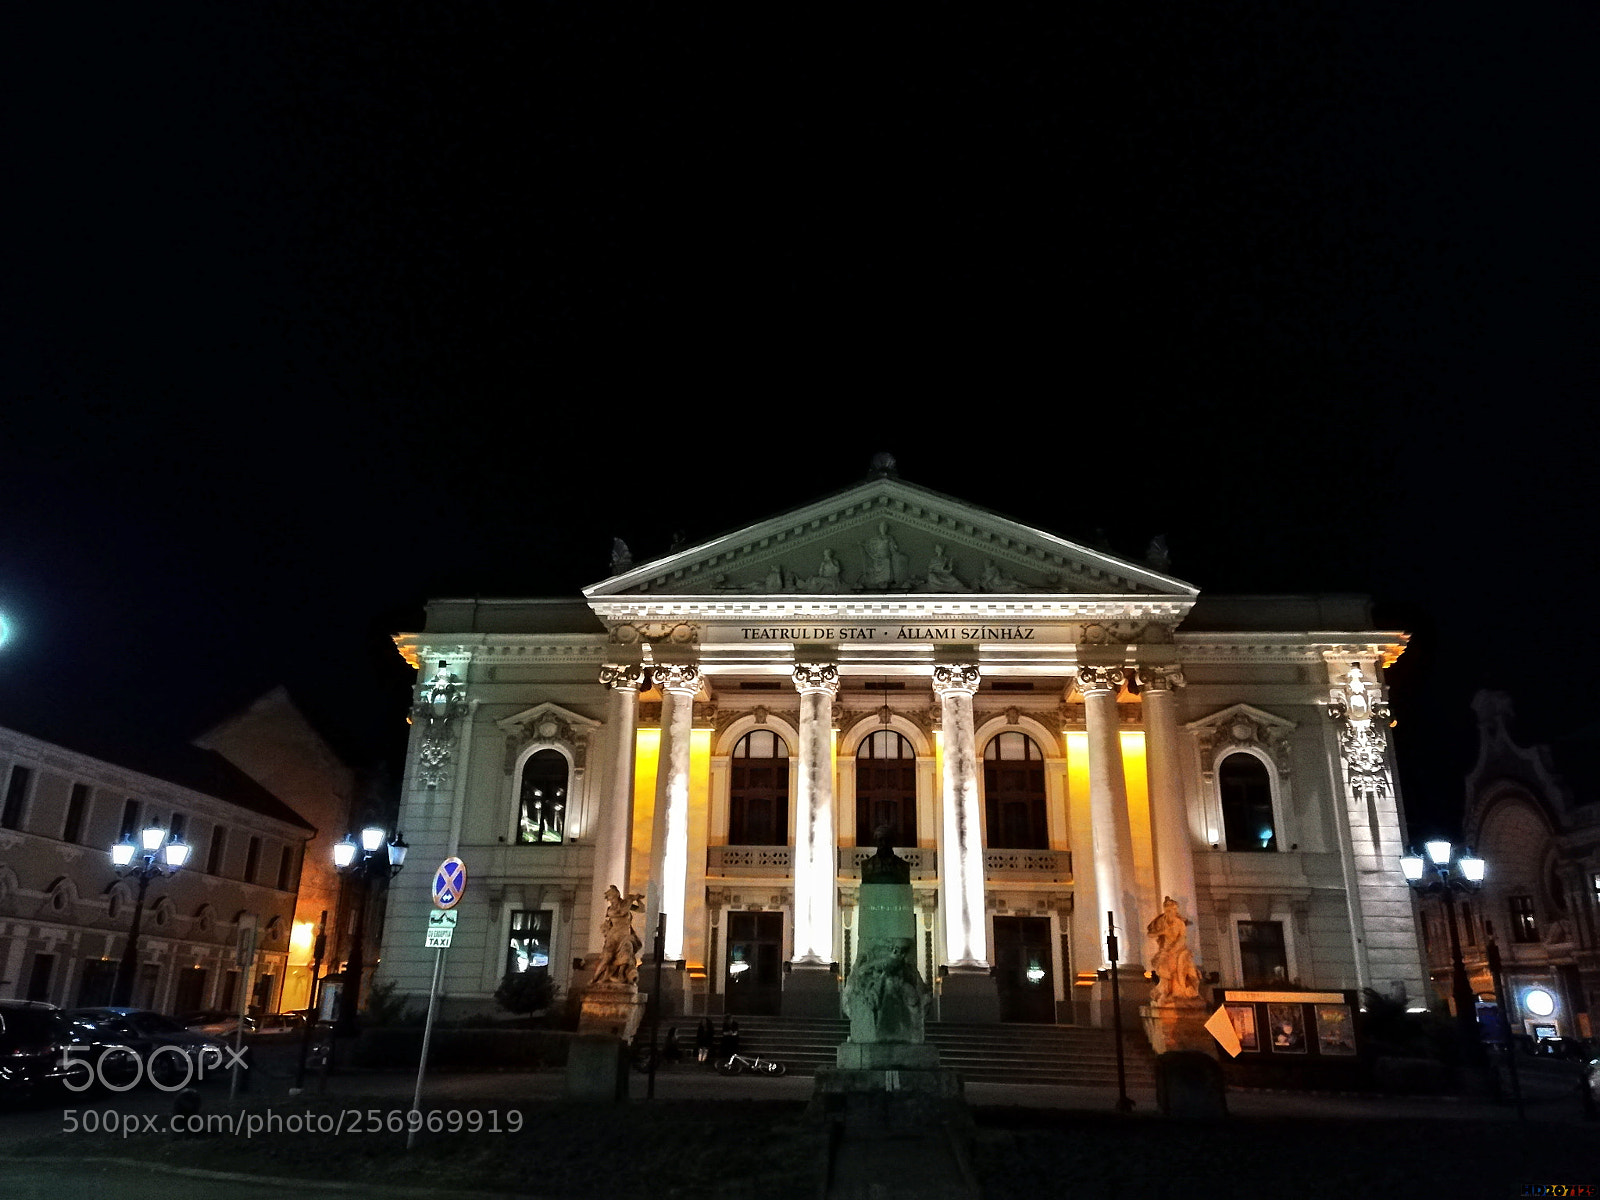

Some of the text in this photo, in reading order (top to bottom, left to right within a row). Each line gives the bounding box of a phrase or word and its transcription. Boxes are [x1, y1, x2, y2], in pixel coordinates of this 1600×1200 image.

[741, 625, 1035, 639] TEATRUL DE STAT ÁLLAMI SZÍNHÁZ
[429, 938, 449, 946] TAXI
